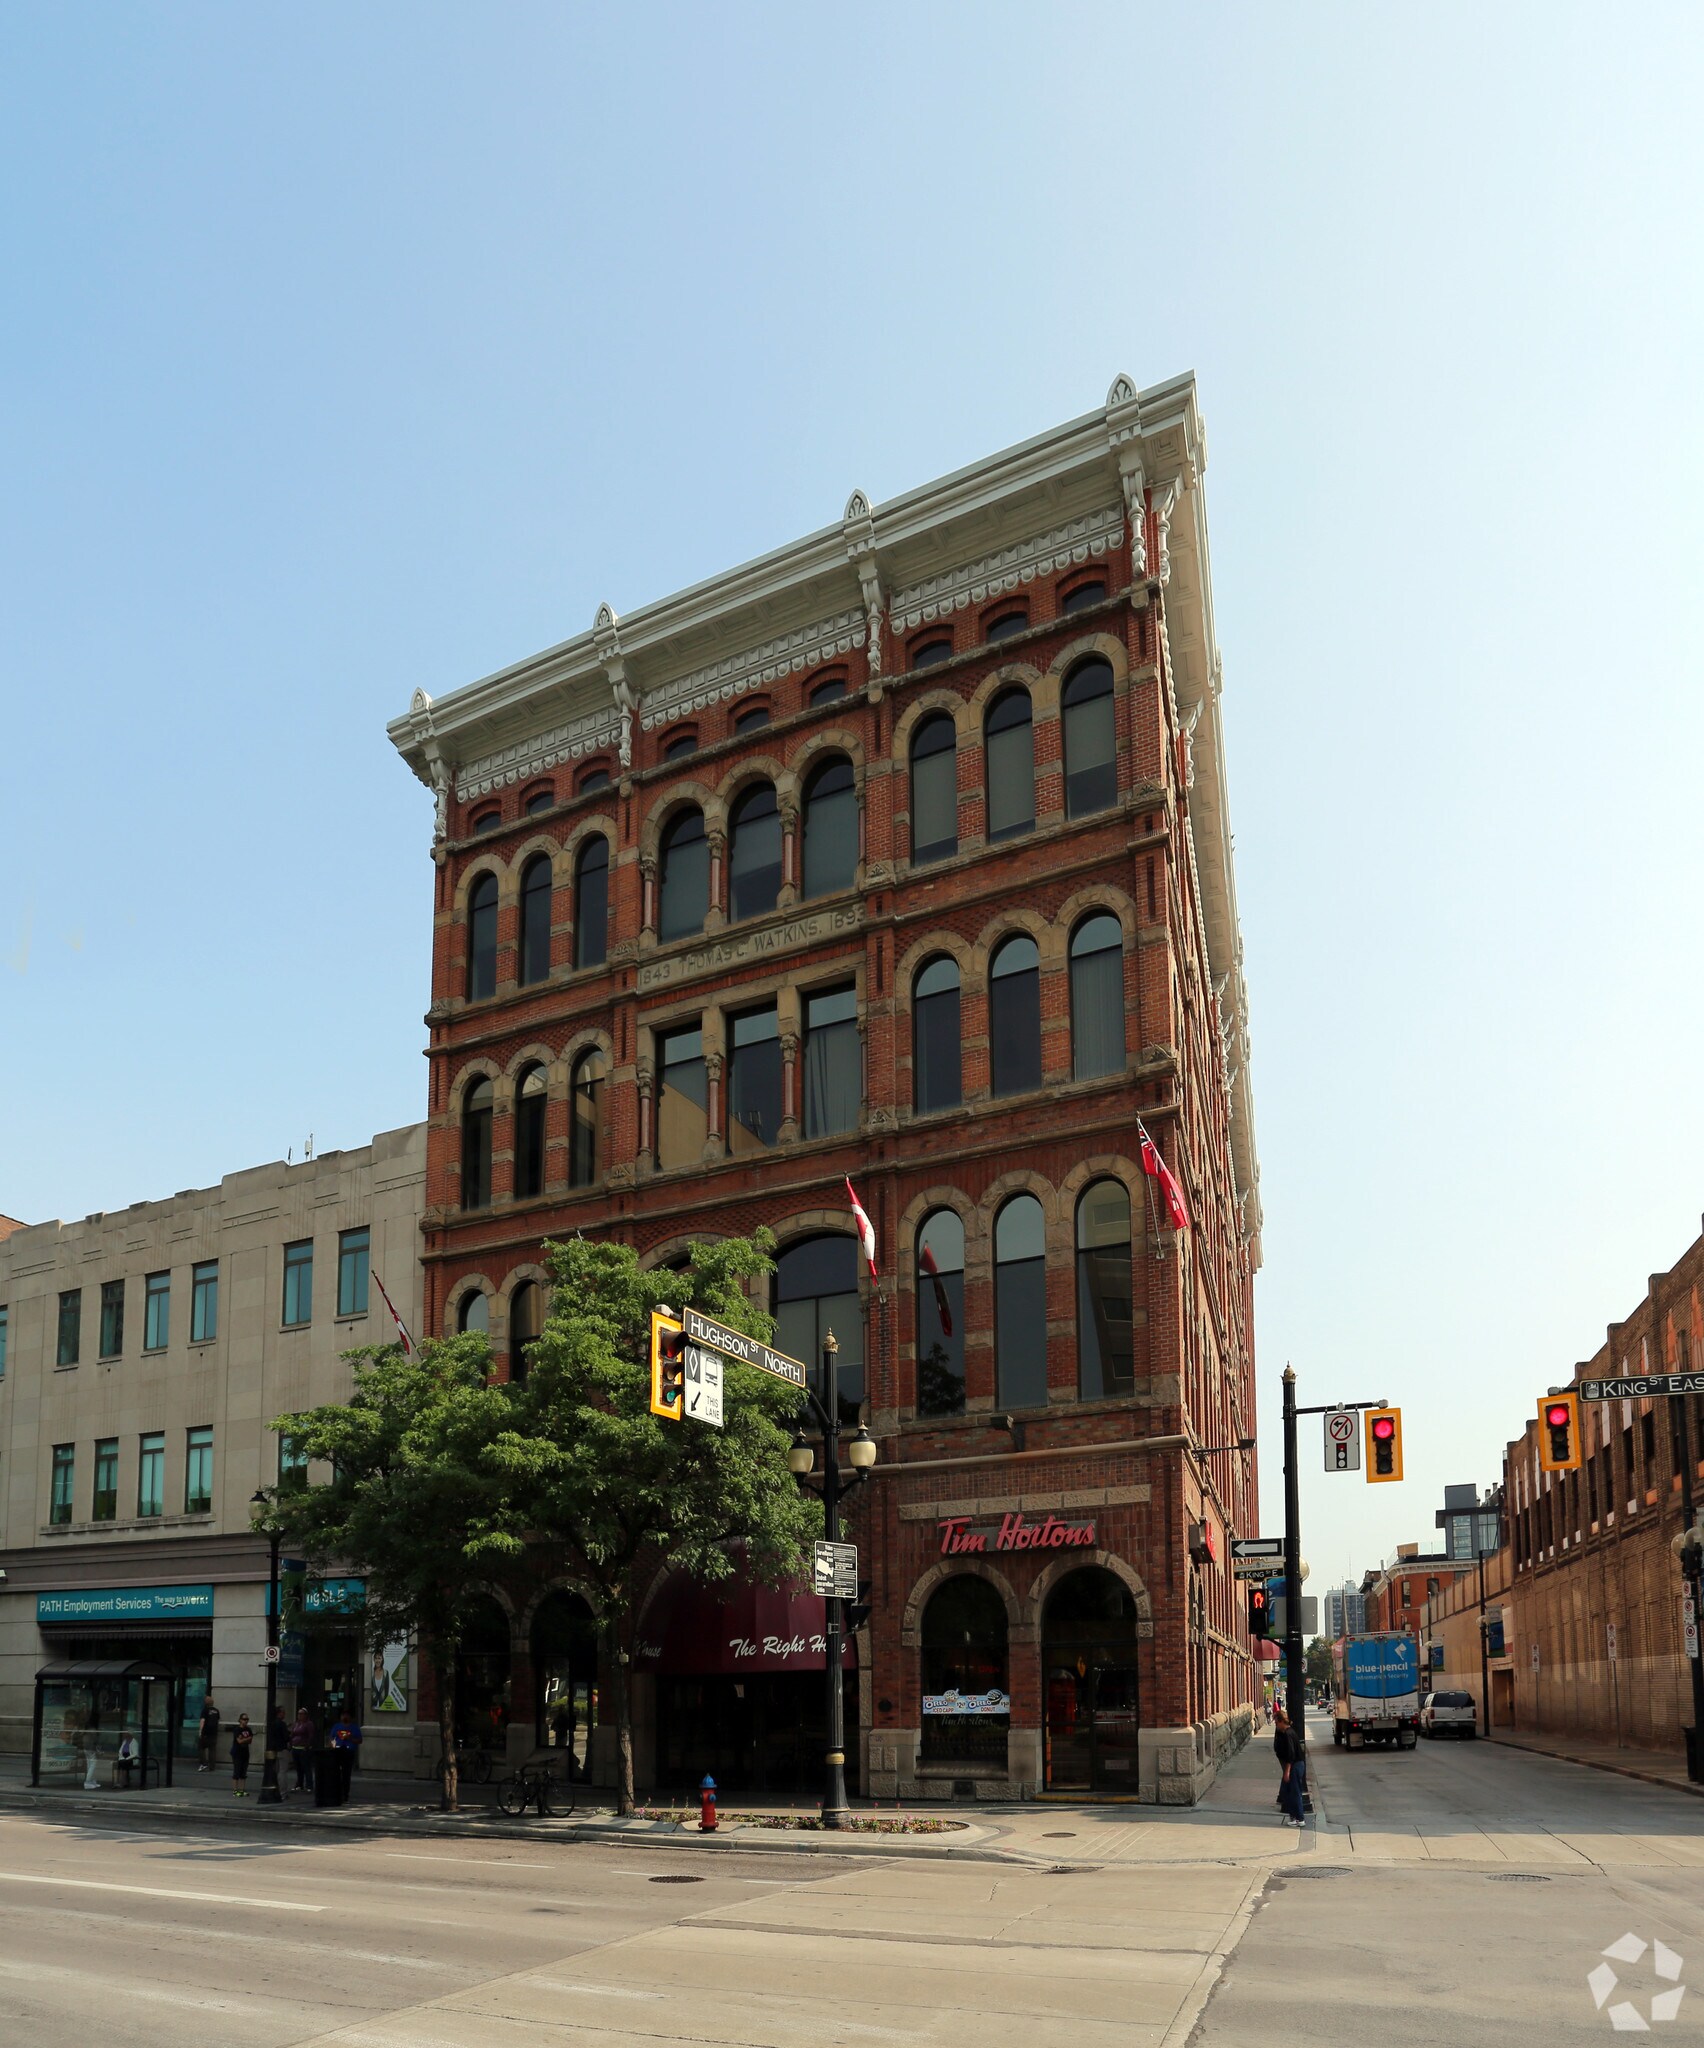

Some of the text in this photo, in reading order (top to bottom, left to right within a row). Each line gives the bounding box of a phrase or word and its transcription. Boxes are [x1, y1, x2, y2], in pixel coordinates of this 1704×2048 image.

[639, 963, 671, 986] 1843
[679, 945, 733, 976] THOMAS
[829, 906, 866, 932] 1893
[690, 1314, 748, 1359] HUGHSON
[764, 1350, 801, 1382] NORTH
[1602, 1381, 1647, 1397] KING
[706, 1395, 719, 1408] THIS
[705, 1406, 720, 1420] LANE
[937, 1512, 1096, 1555] Tim Hortons
[1246, 1571, 1265, 1579] KING
[1272, 1569, 1278, 1577] E
[39, 1599, 62, 1612] PATH
[63, 1597, 114, 1613] Employment
[115, 1596, 152, 1610] Services
[154, 1595, 164, 1603] The
[729, 1638, 757, 1659] The
[762, 1634, 806, 1660] Right
[1355, 1662, 1408, 1674] blue-pencil
